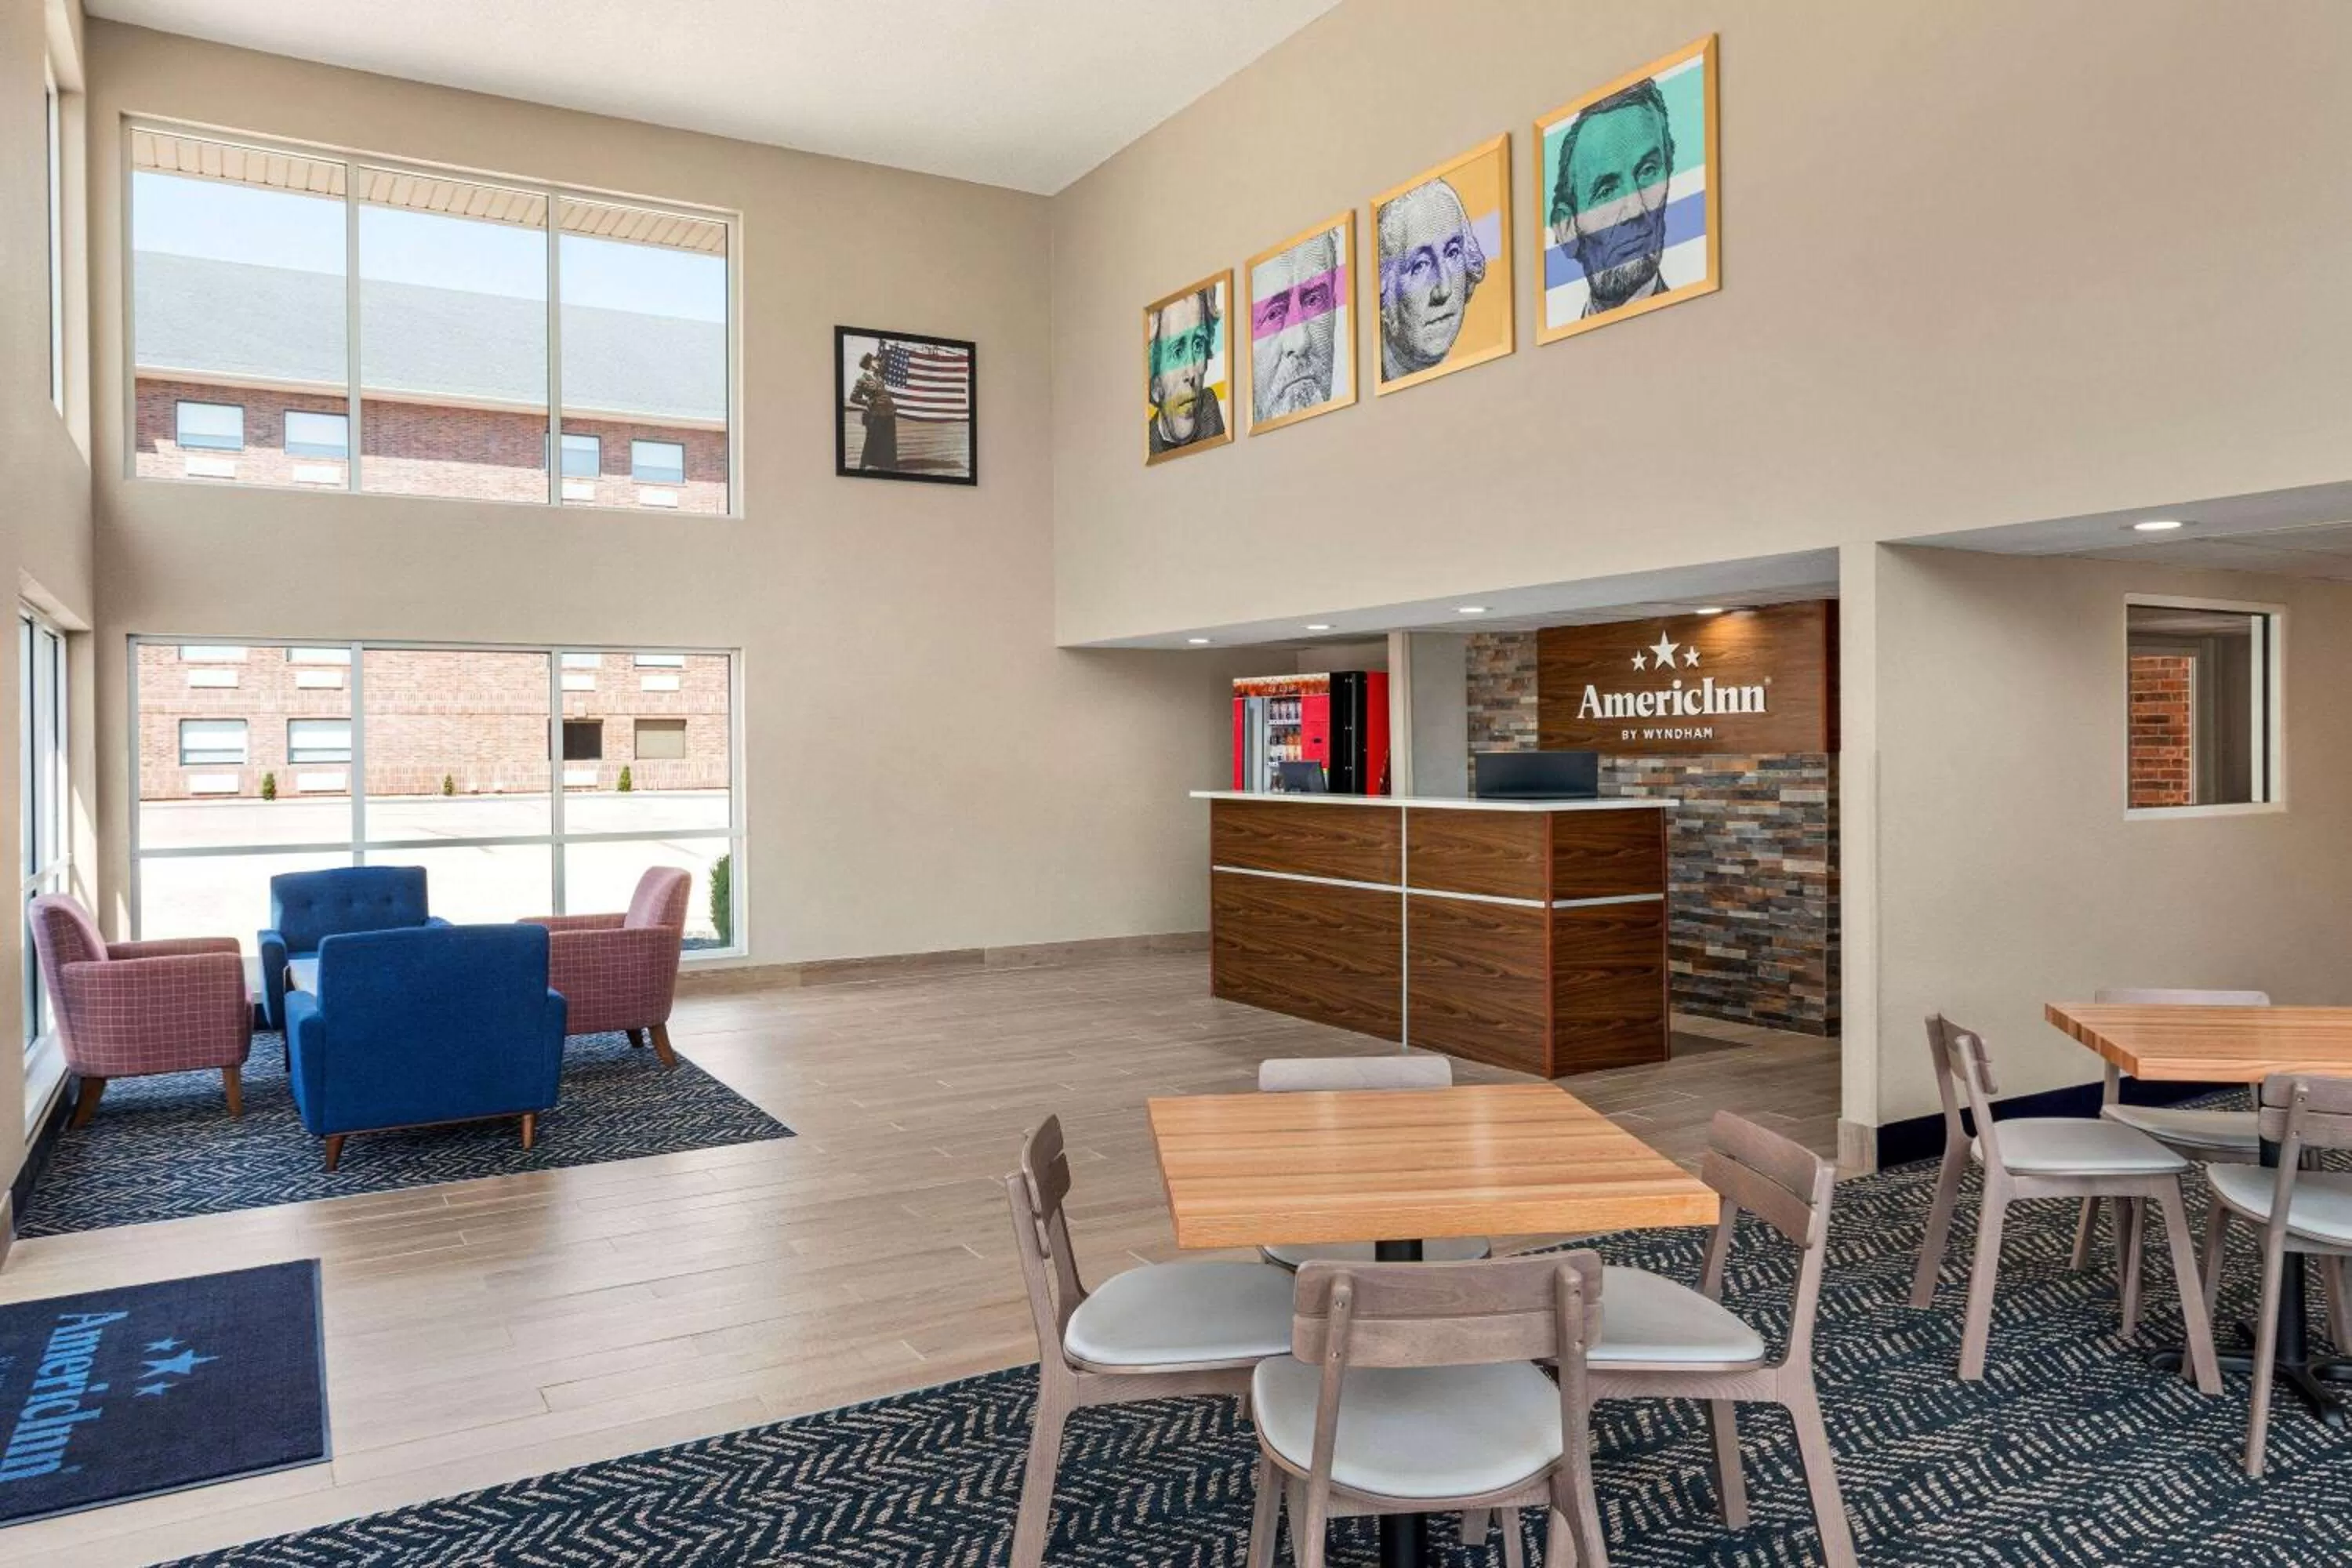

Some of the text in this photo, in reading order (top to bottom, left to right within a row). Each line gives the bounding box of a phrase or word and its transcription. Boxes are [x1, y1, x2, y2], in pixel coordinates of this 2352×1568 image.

[1577, 677, 1766, 719] AmericInn
[1621, 727, 1714, 740] BY WYNDHAM
[0, 1311, 129, 1482] AmericInn
